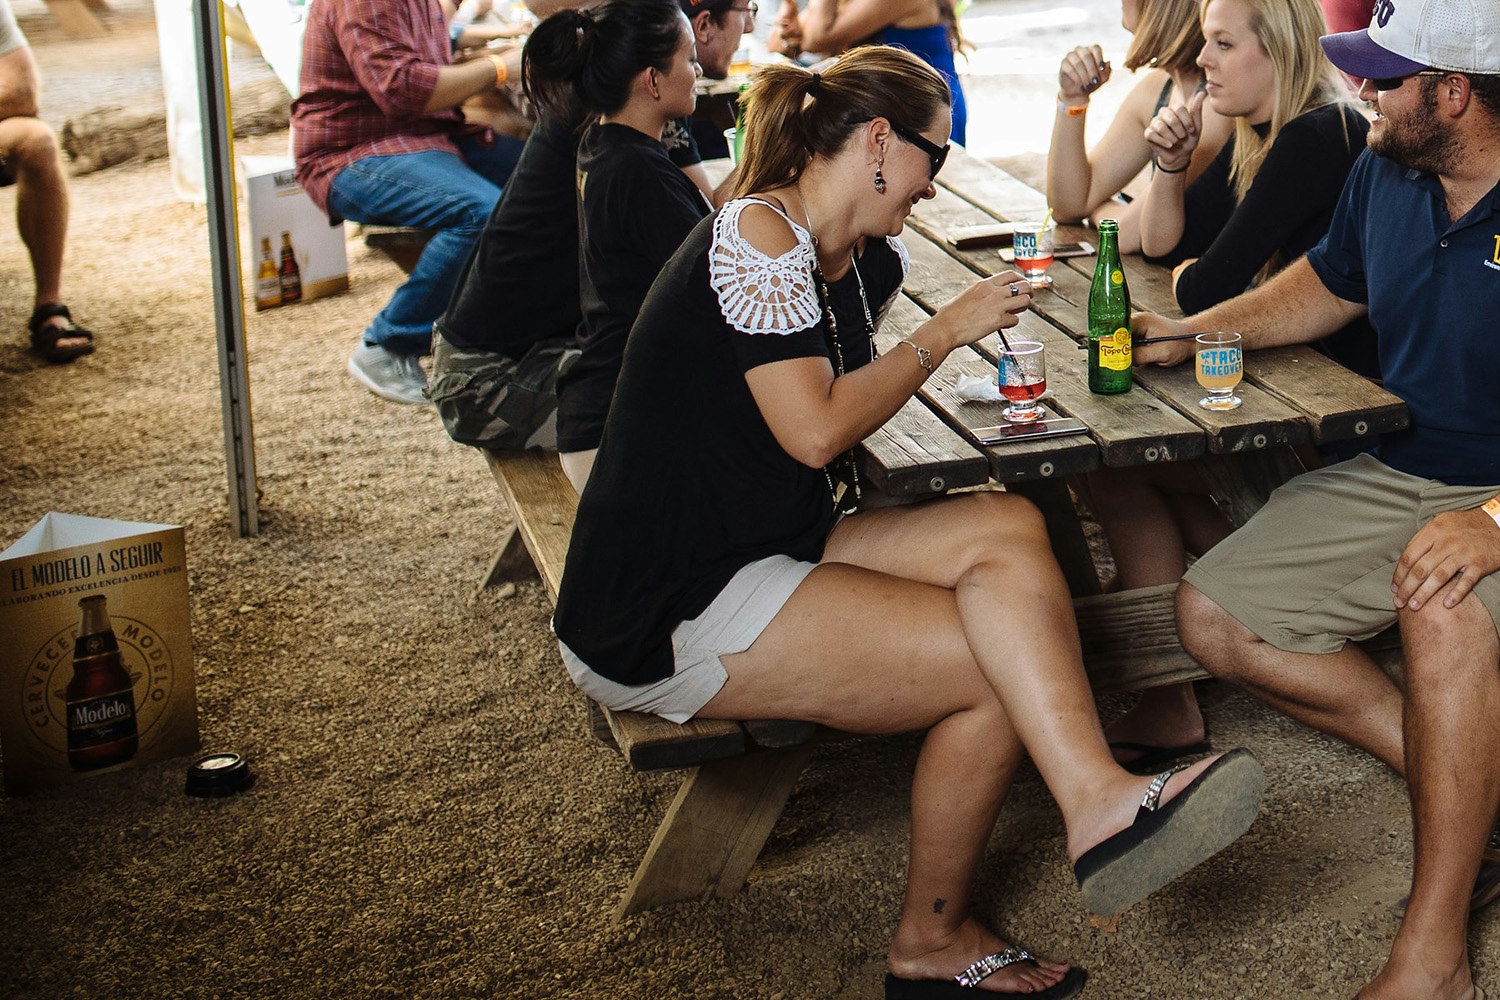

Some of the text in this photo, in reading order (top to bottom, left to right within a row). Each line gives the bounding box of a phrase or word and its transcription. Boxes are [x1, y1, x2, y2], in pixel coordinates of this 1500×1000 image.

[1101, 344, 1122, 357] Topo
[1210, 346, 1241, 365] TACO
[11, 540, 164, 593] EL MODELO A SEGUIR
[68, 577, 130, 595] EXCELENCIA
[131, 569, 161, 582] DESDE
[121, 624, 168, 702] MODELO
[75, 700, 127, 726] Modelo
